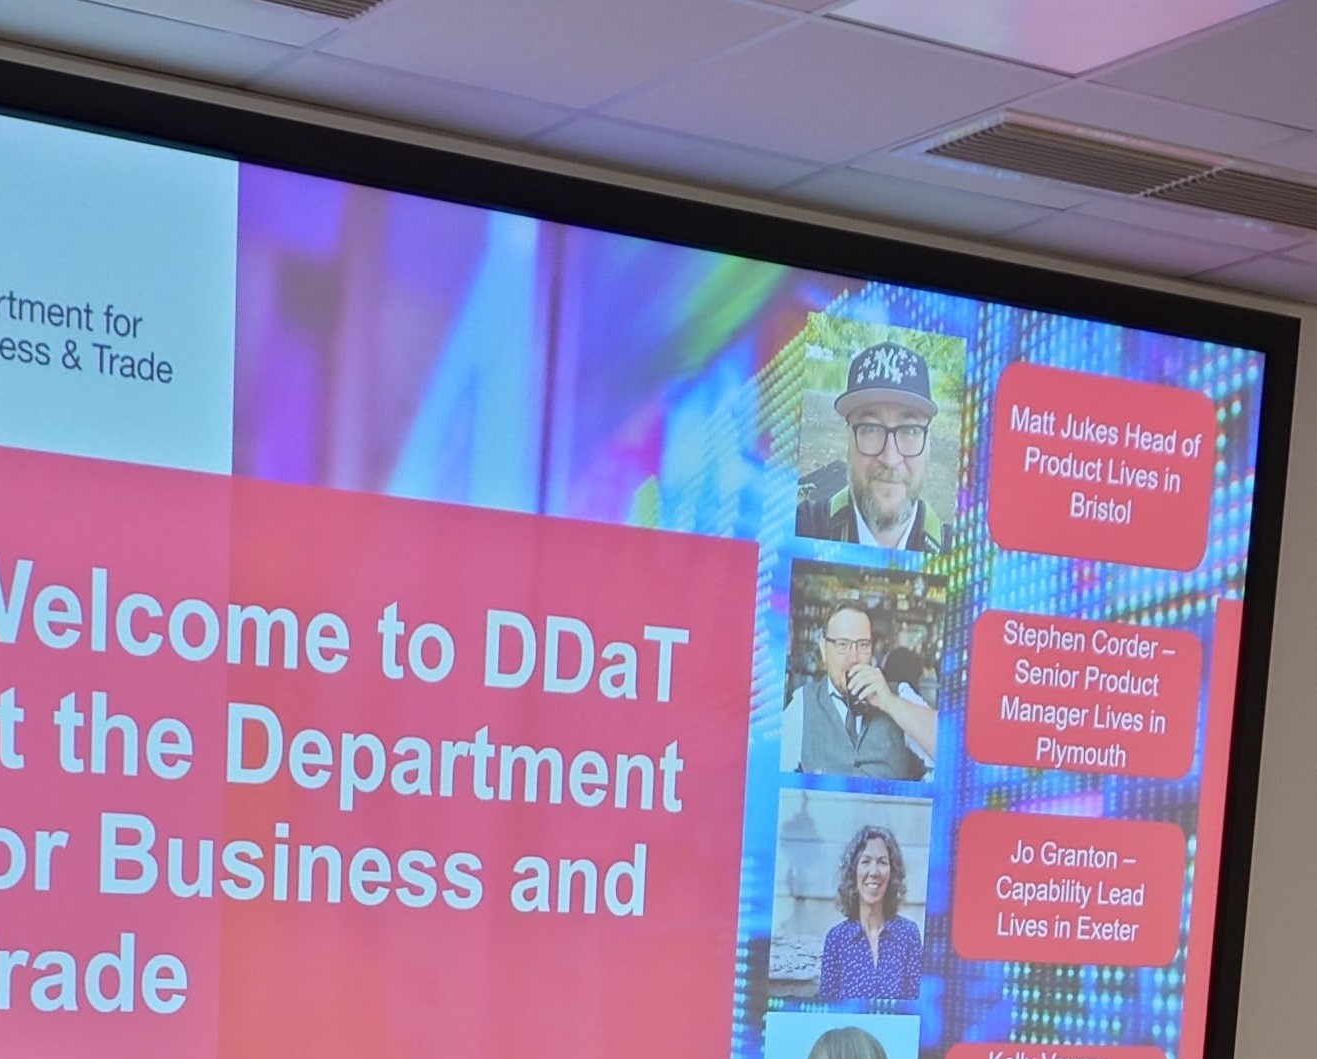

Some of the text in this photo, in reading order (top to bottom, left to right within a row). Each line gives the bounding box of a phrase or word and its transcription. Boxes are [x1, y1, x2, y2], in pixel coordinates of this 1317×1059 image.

[103, 304, 143, 339] for
[61, 339, 82, 371] &
[92, 342, 173, 384] Trade
[1010, 404, 1202, 458] Matt Jukes Head of
[1024, 446, 1180, 493] Product Lives in
[1070, 491, 1132, 524] Bristol
[377, 602, 455, 683] to
[484, 609, 689, 702] DDaT
[1003, 619, 1085, 653] Stephen
[1092, 629, 1159, 659] Corder
[1014, 659, 1159, 697] Senior Product
[1001, 695, 1166, 734] Manager Lives in
[53, 691, 193, 780] the
[226, 702, 684, 813] Department
[1036, 737, 1126, 769] Plymouth
[100, 812, 483, 910] Business
[511, 843, 647, 916] and
[1010, 839, 1034, 864] Jo
[1040, 841, 1118, 869] Granton
[996, 875, 1145, 909] Capability Lead
[997, 912, 1139, 942] Lives in Exeter
